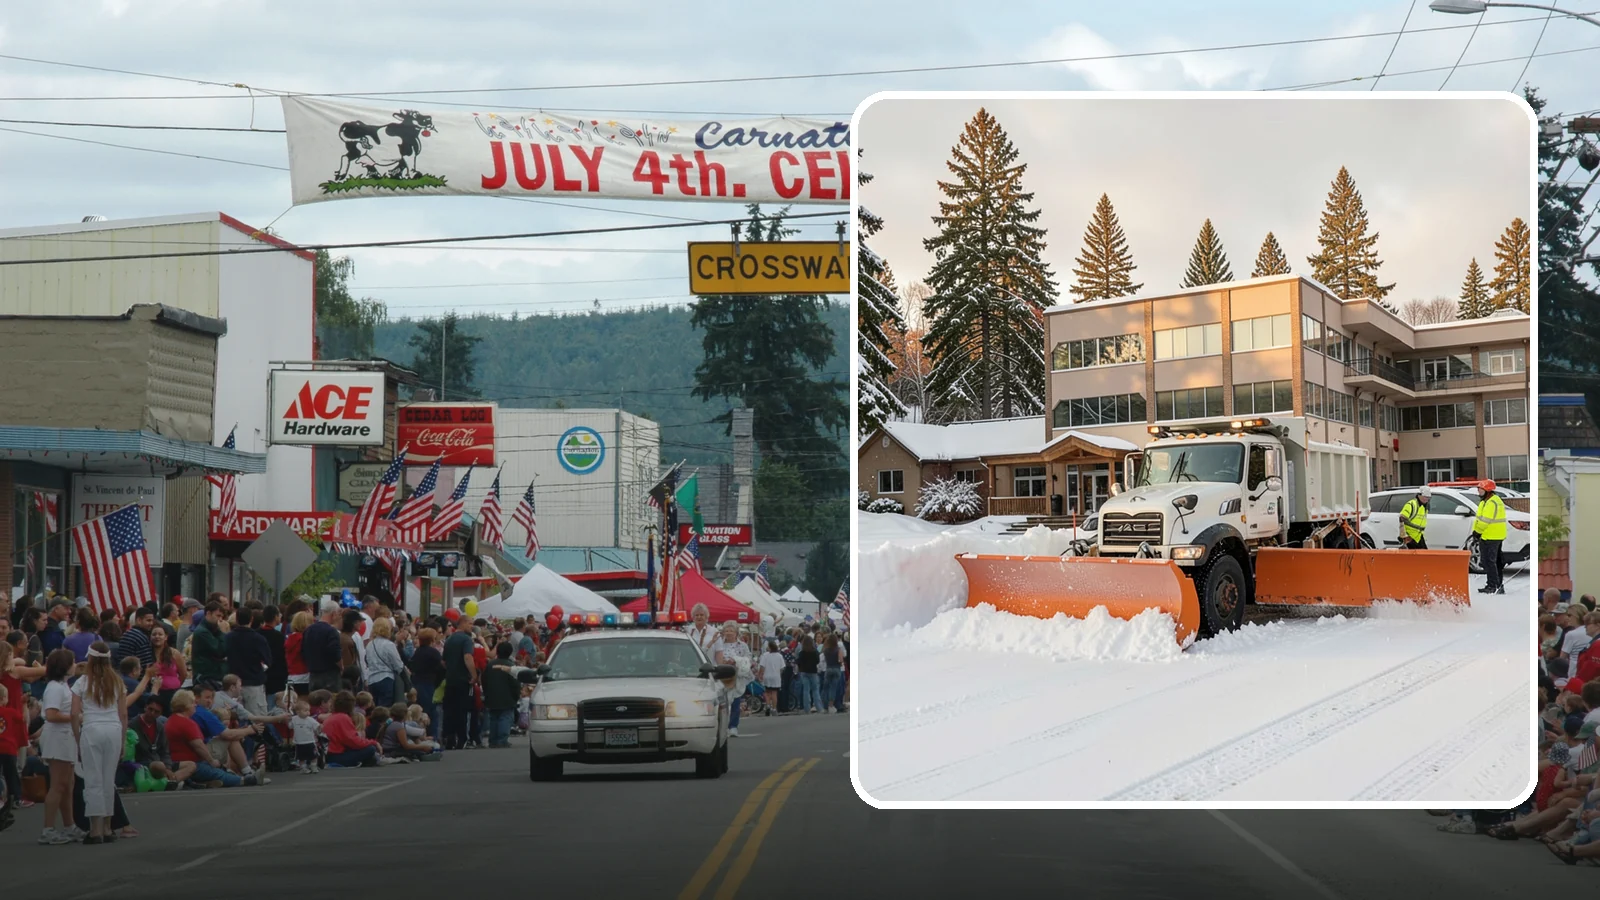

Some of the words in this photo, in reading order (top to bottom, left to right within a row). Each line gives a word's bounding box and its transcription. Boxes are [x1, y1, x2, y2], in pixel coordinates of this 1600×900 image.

[695, 121, 850, 150] Carnat
[481, 141, 604, 192] JULY
[632, 150, 746, 197] 4th.
[697, 254, 850, 280] CROSSWA
[282, 380, 373, 420] ACE
[406, 409, 452, 422] CEDAR
[283, 421, 370, 436] Hardware
[83, 485, 93, 494] St.
[96, 485, 124, 495] Vincent
[126, 486, 136, 494] de
[138, 486, 155, 495] Paul
[213, 516, 331, 535] HARDARE
[688, 526, 741, 535] CRNATION
[699, 535, 730, 543] GLASS
